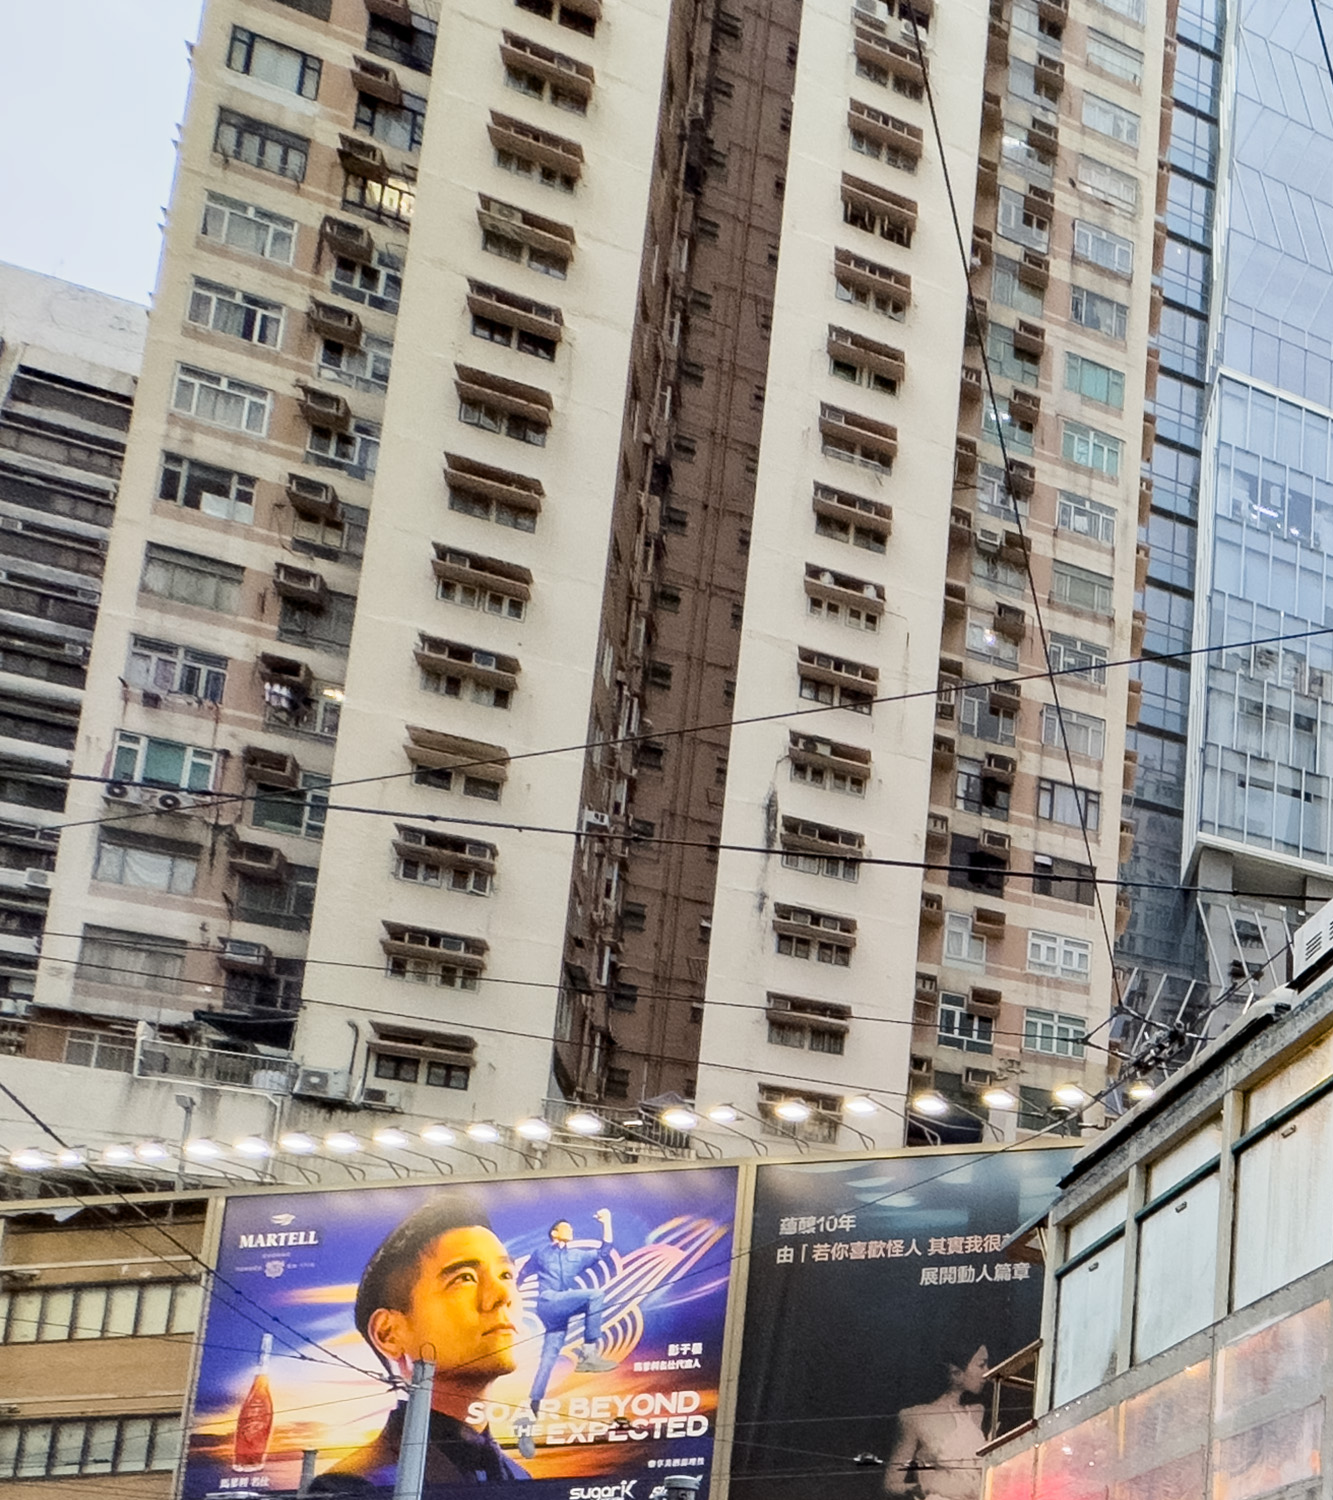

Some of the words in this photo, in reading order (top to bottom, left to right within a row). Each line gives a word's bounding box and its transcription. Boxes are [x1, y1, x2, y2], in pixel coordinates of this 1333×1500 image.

[238, 1230, 319, 1249] MARTELL
[927, 1233, 1012, 1257] 其實我很
[919, 1261, 1031, 1286] 展開動人篇章
[465, 1397, 561, 1426] SOAR
[568, 1390, 701, 1419] BEYOND
